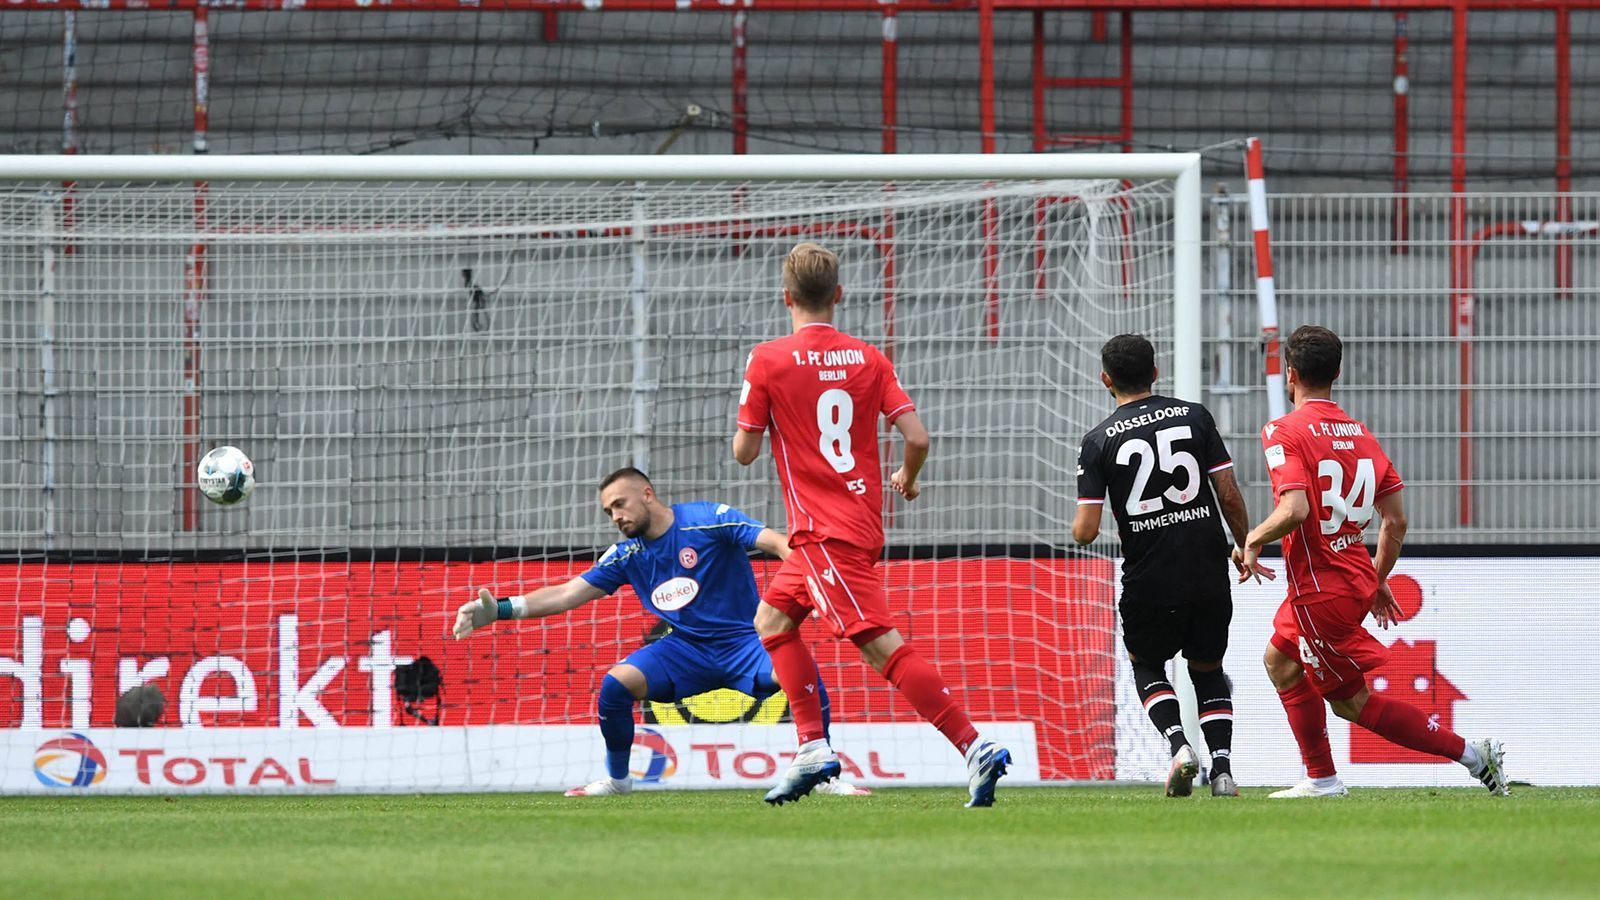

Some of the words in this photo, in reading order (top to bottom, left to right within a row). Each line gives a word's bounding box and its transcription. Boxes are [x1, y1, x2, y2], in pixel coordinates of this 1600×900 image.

[824, 348, 865, 366] UNION
[818, 370, 847, 381] BERLIN
[817, 388, 856, 473] 8
[1105, 406, 1190, 438] DÜSSELDORF
[1331, 423, 1364, 437] UNION
[1332, 440, 1355, 450] BERLIN
[1116, 425, 1200, 516] 25
[845, 478, 866, 495] ES
[1318, 458, 1376, 535] 34
[1129, 506, 1210, 532] ZIMMERMANN
[118, 748, 337, 786] TOTAL
